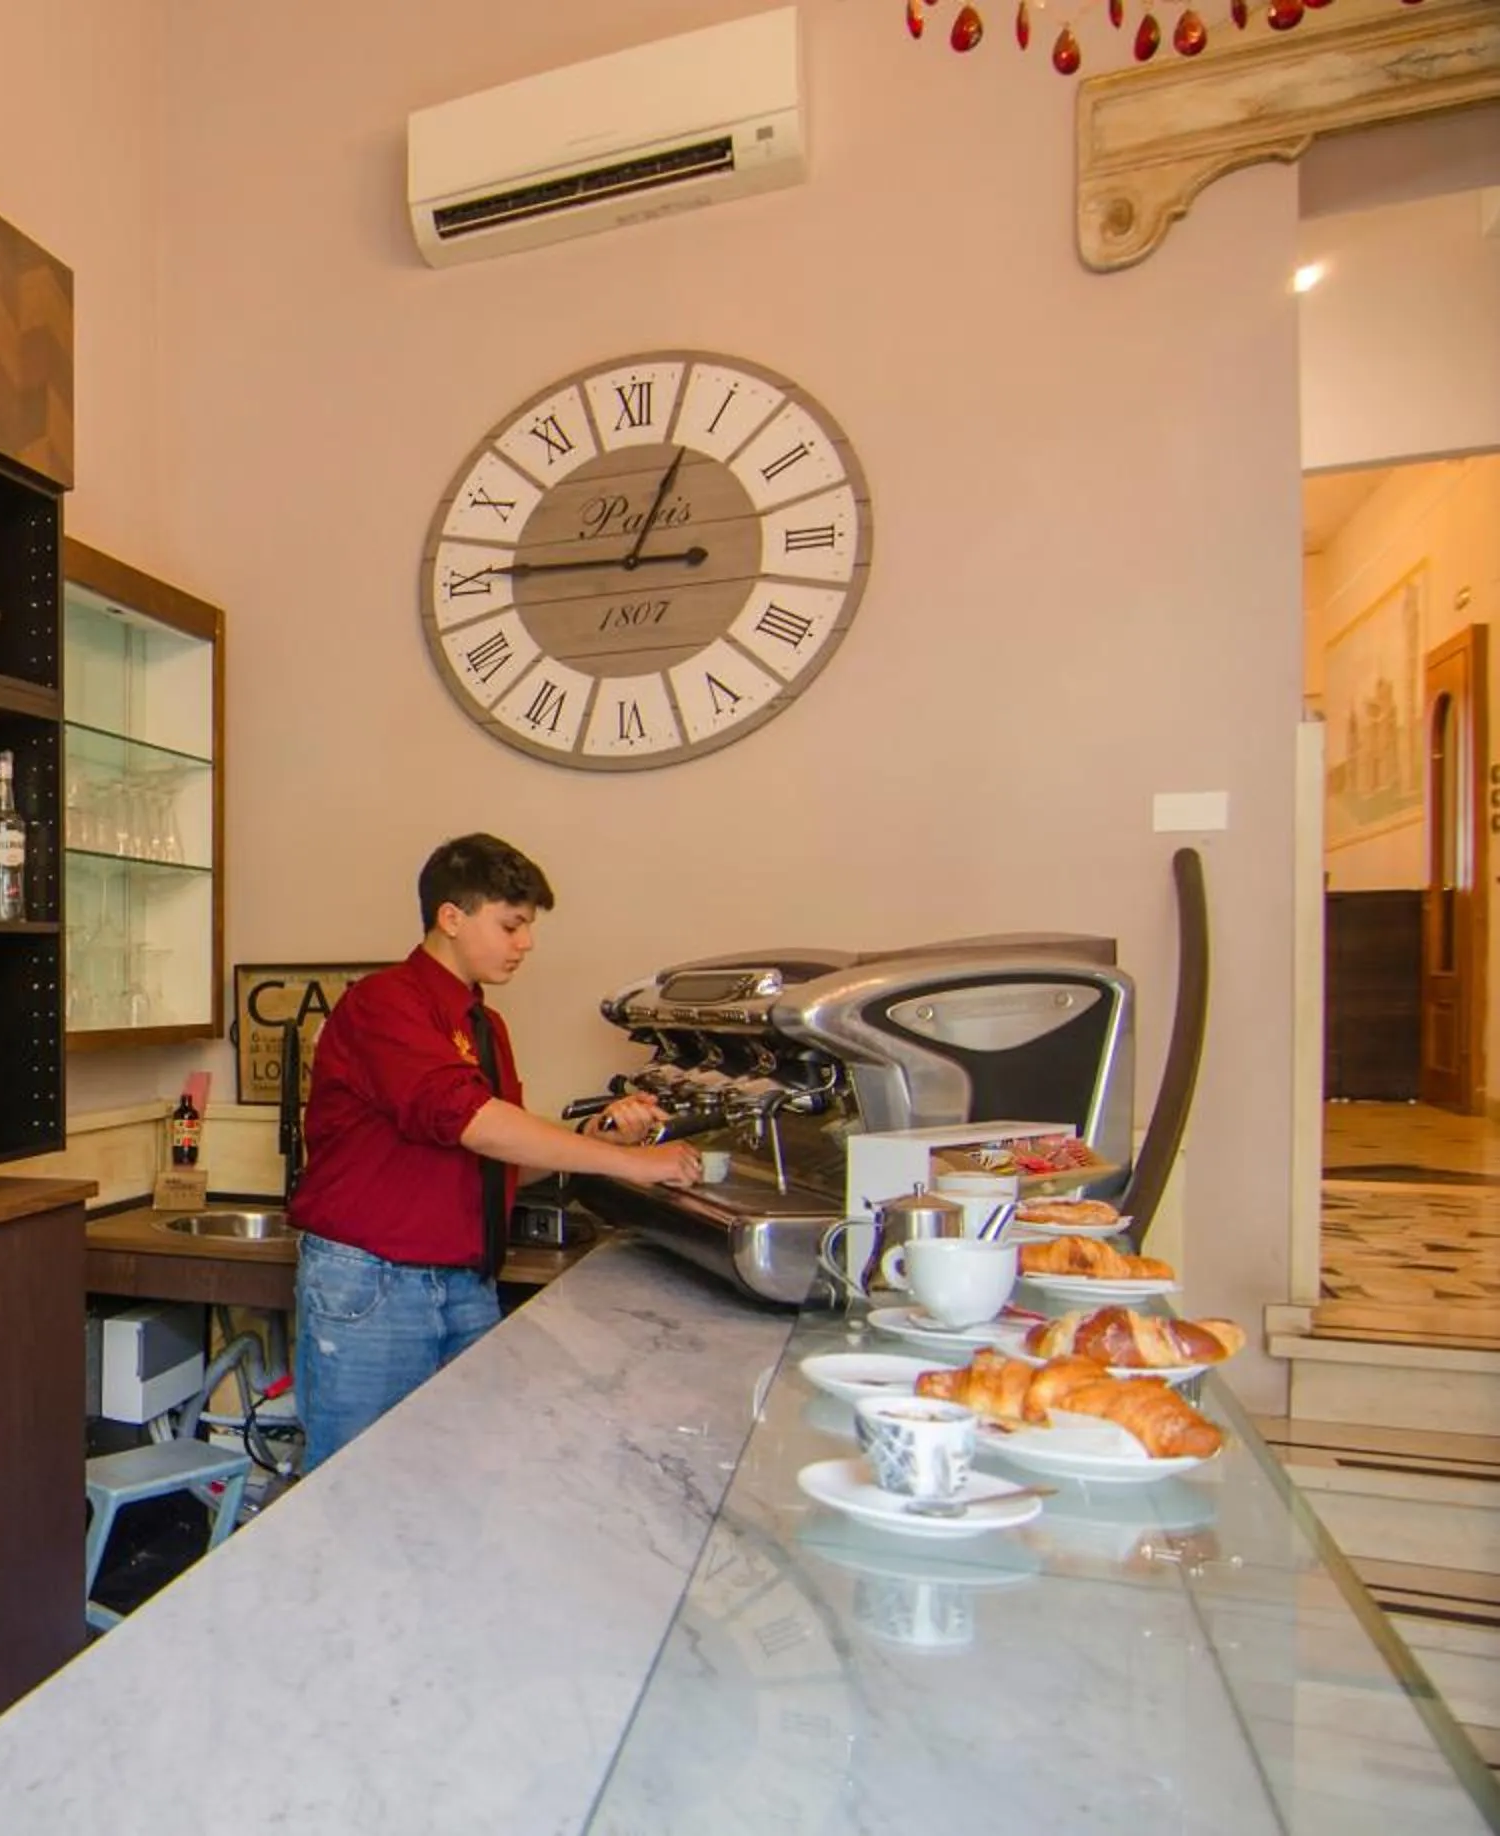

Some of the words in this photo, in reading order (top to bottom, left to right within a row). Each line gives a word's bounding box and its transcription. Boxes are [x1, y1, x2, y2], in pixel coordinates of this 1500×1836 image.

[578, 495, 692, 540] Paris
[598, 600, 671, 632] 1807
[247, 980, 357, 1027] CA
